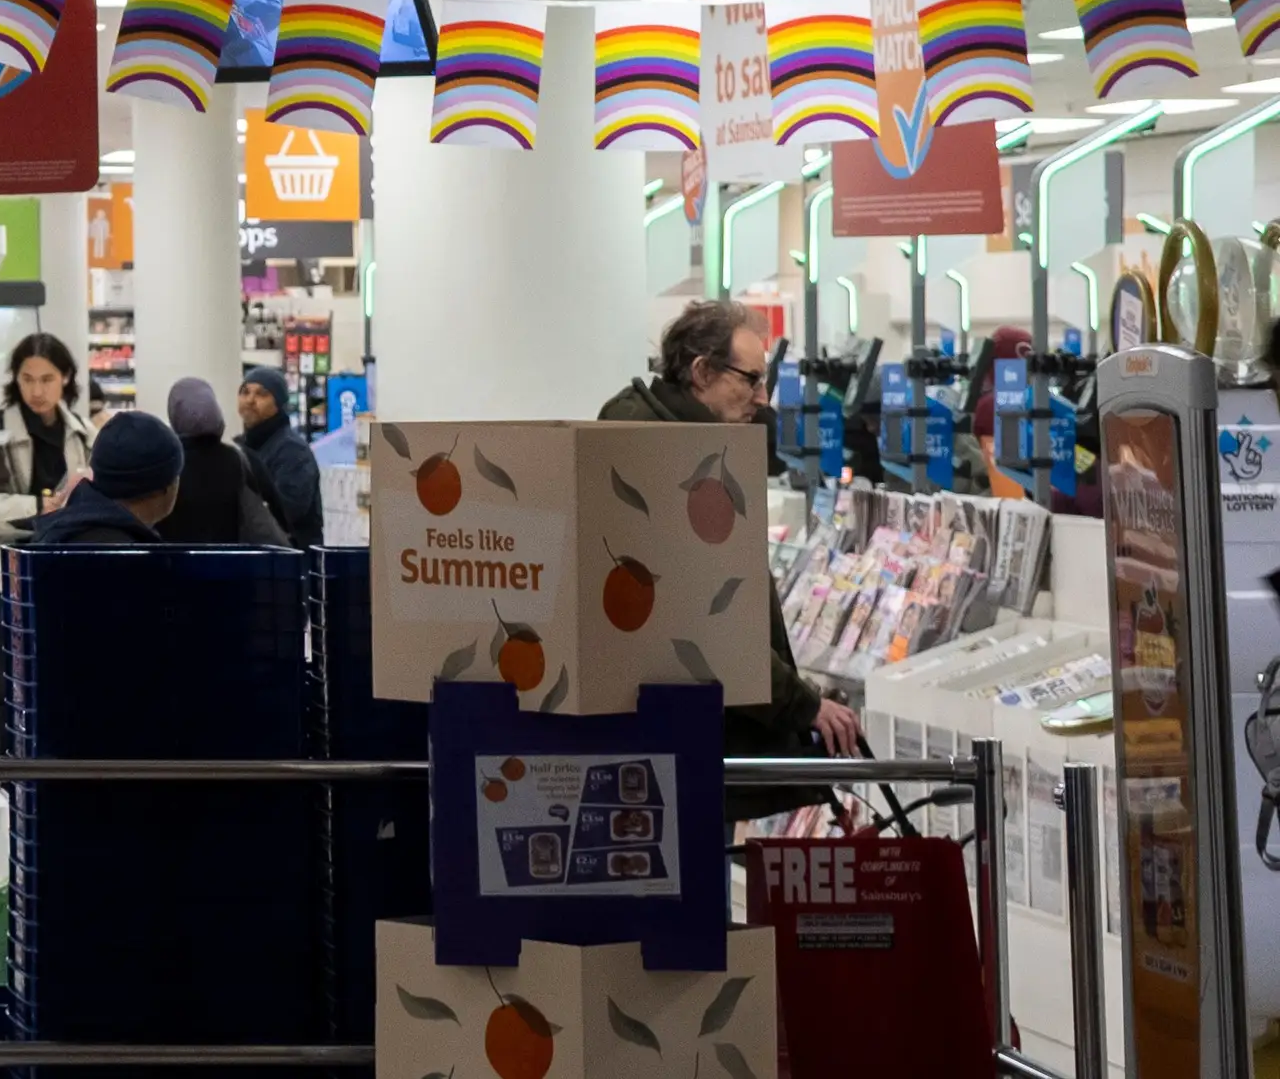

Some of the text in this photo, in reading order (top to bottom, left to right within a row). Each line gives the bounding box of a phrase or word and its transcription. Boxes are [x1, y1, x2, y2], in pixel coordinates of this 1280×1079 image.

[715, 54, 736, 104] to
[1223, 494, 1277, 502] NATIONAL
[1227, 502, 1276, 513] LOTTERY
[426, 528, 515, 552] Feels like
[400, 548, 544, 592] Summer
[762, 846, 858, 904] FREE
